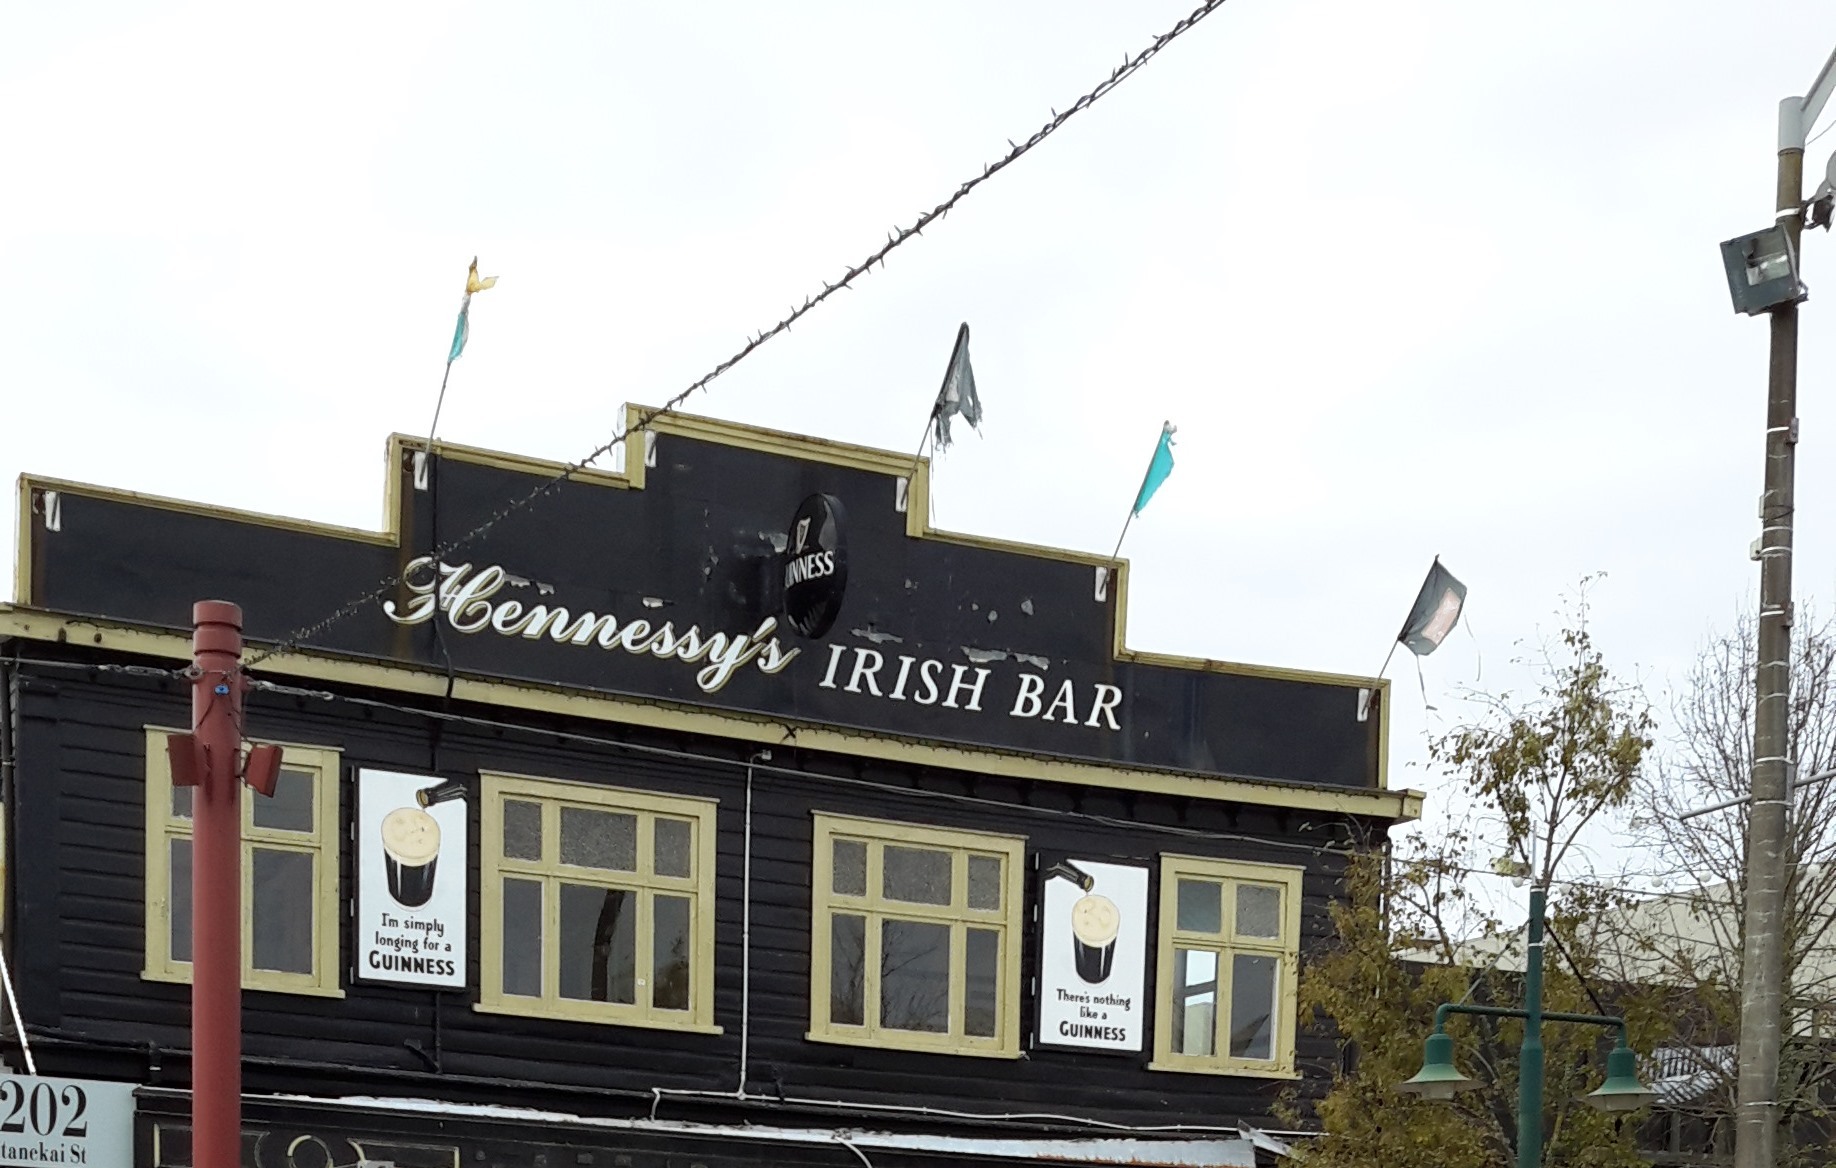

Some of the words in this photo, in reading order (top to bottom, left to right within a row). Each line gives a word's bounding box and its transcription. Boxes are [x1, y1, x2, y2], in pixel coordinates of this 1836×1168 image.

[383, 555, 801, 692] Hennessy's
[818, 643, 991, 712] IRISH
[1009, 673, 1123, 731] BAR
[404, 916, 444, 938] simply
[375, 931, 419, 953] longing
[423, 936, 439, 951] for
[445, 943, 451, 951] a
[369, 951, 455, 976] GUINNESS
[1080, 1006, 1098, 1019] like
[1093, 994, 1131, 1011] nothing
[1060, 1021, 1125, 1041] GUINNESS
[0, 1080, 87, 1138] 202
[70, 1143, 86, 1164] St
